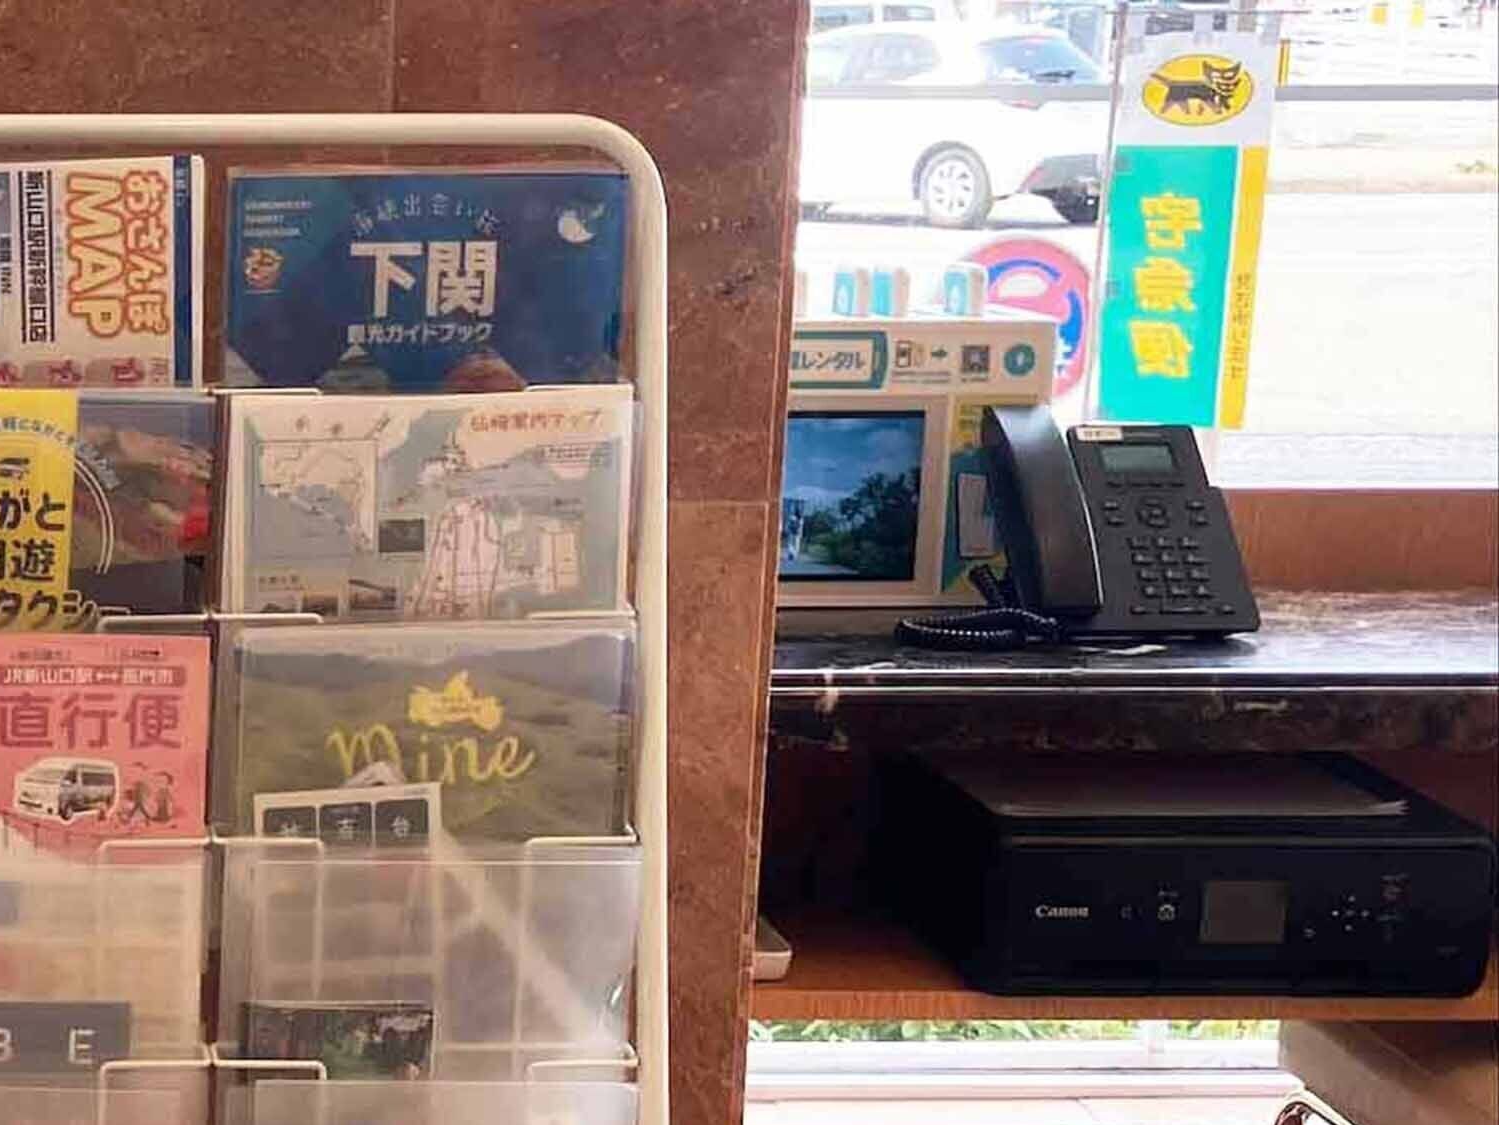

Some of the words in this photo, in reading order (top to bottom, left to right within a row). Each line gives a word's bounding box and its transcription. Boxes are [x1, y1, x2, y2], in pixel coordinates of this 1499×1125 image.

[67, 170, 125, 339] MAP
[124, 169, 169, 336] おさんぽ
[350, 240, 498, 318] 下関
[346, 322, 492, 344] 観光ガイドブック
[791, 351, 867, 370] レンタル
[1034, 905, 1090, 918] Canon
